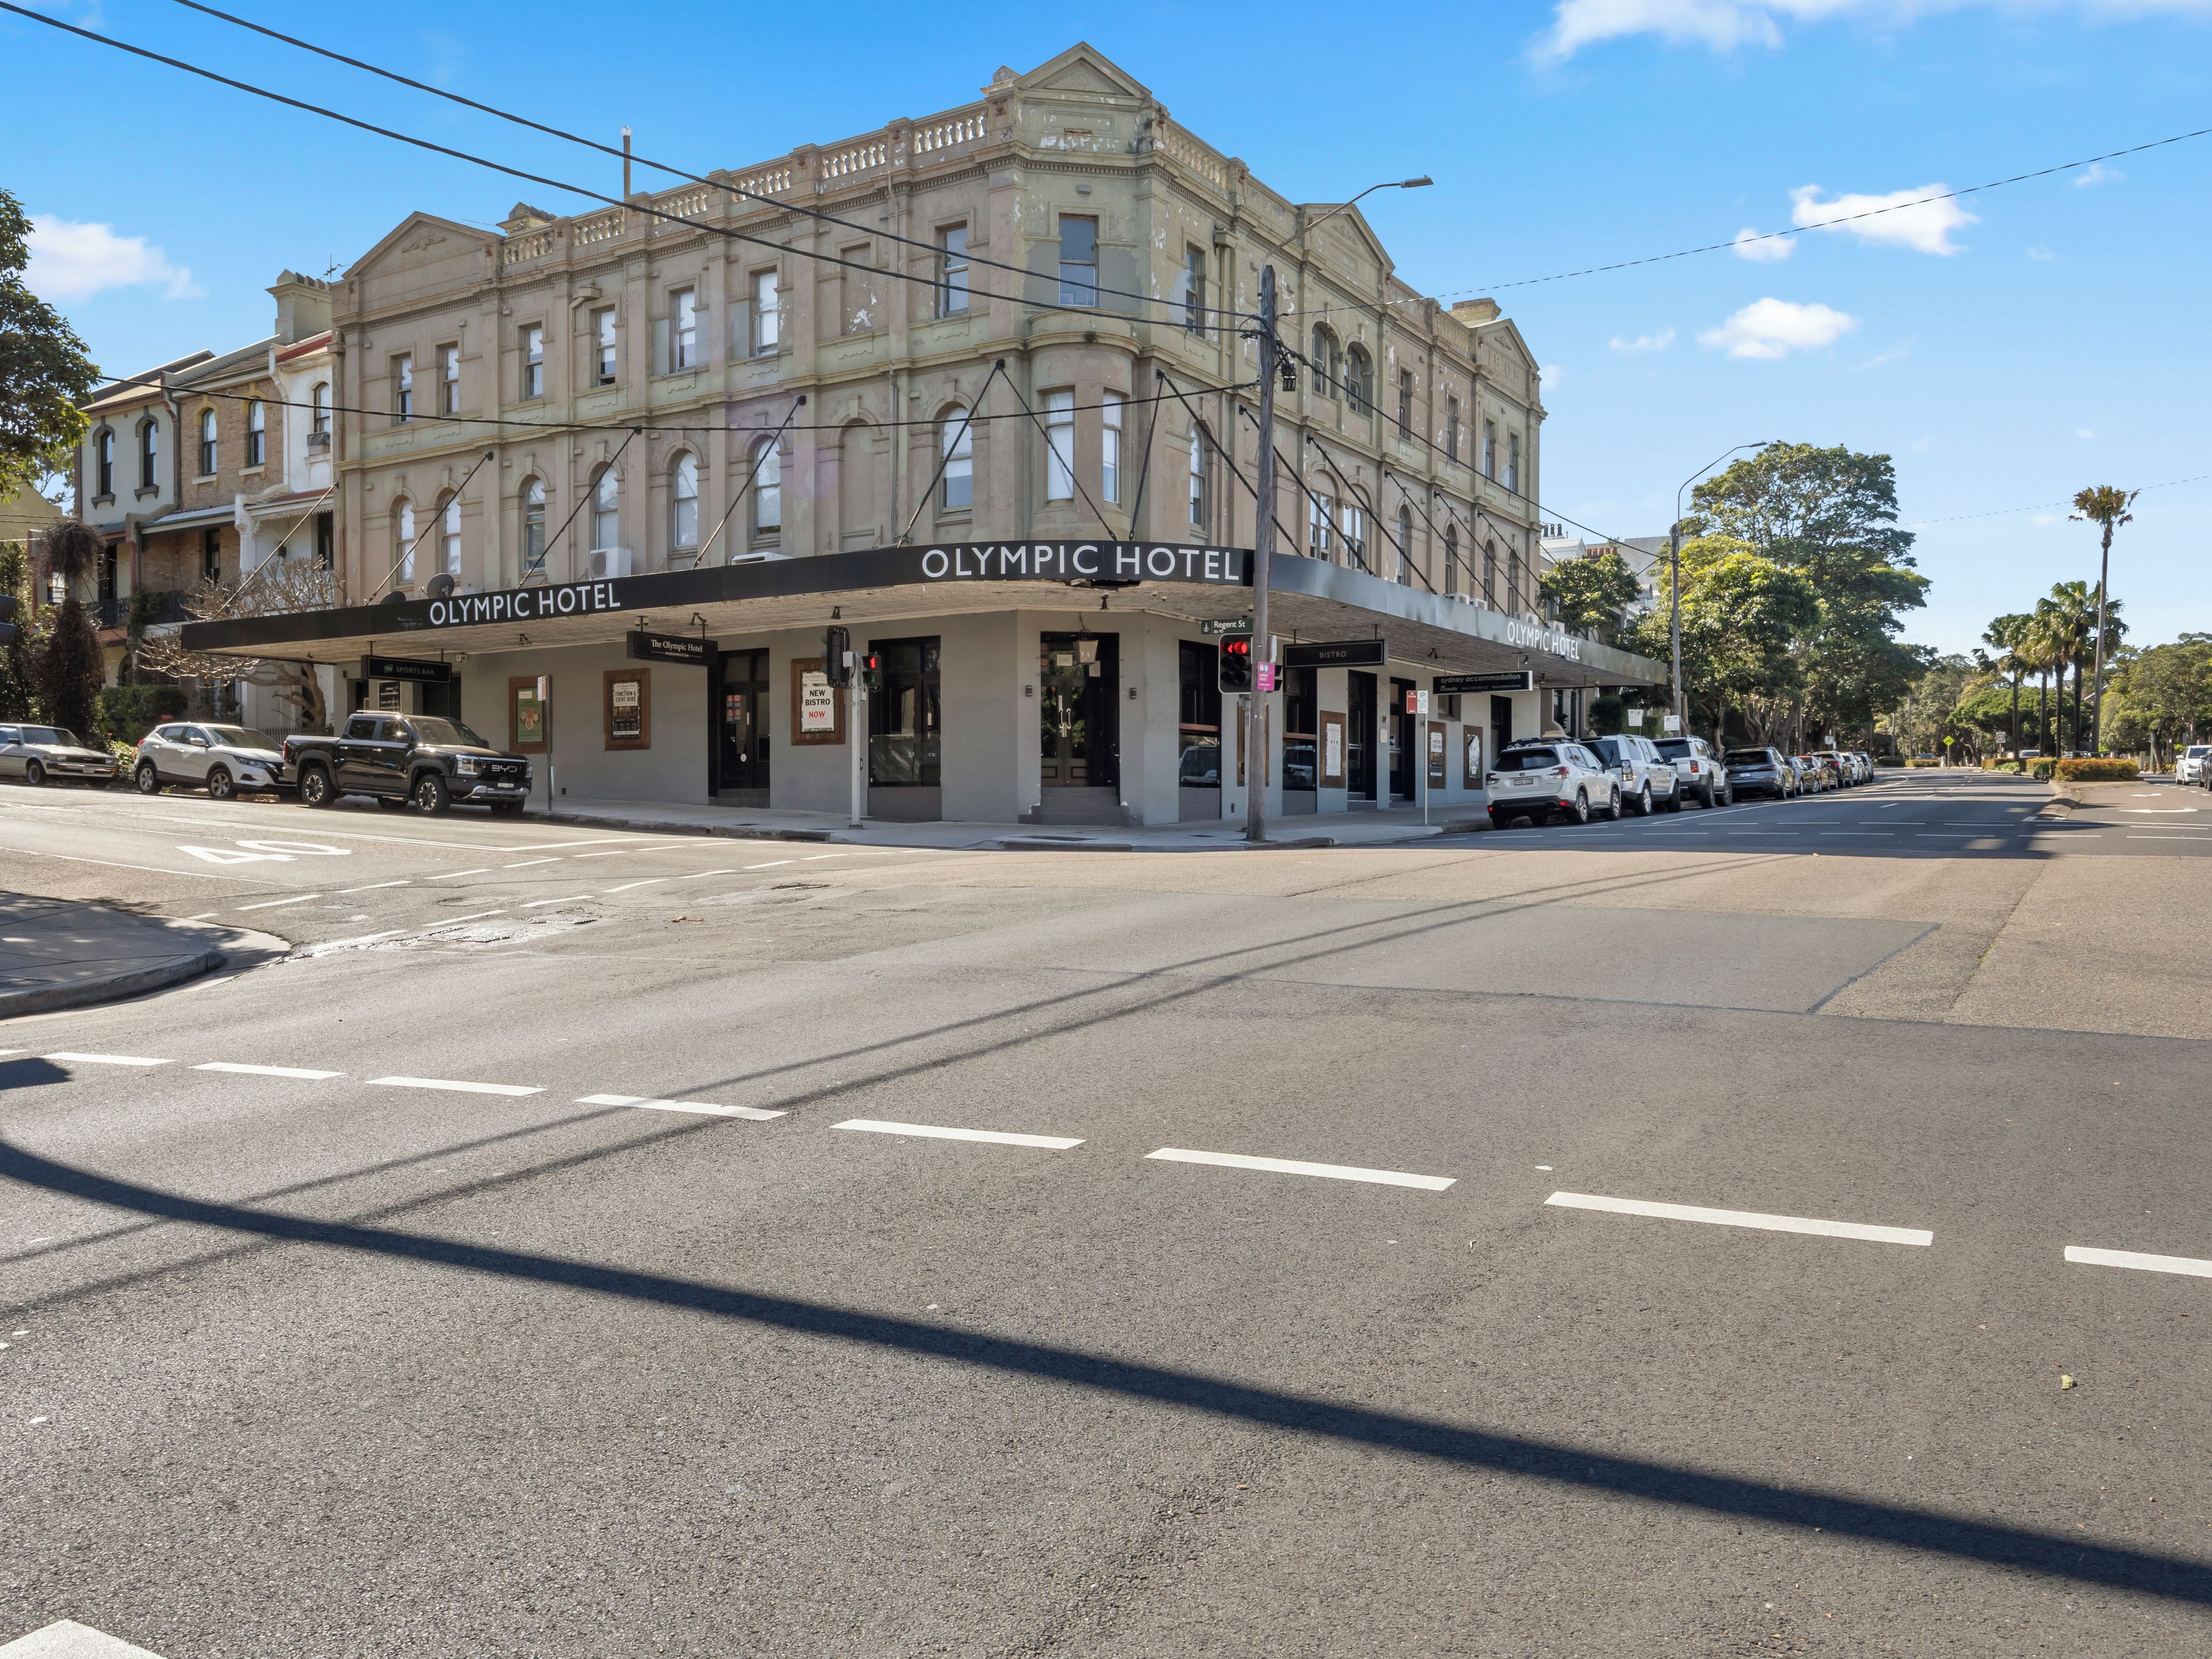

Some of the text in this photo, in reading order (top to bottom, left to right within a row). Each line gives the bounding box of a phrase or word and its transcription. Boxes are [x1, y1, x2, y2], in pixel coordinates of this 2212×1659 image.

[922, 545, 1239, 580] OLYMPIC HOTEL
[430, 583, 620, 625] OLYMPIC HOTEL
[1214, 621, 1236, 630] Regent
[651, 639, 703, 652] The Olympic Hotel
[1508, 622, 1580, 660] OLYMPIC HOTEL
[396, 666, 421, 675] SPORTS
[1441, 673, 1521, 684] sydney accommodation
[805, 698, 830, 706] BISTRO
[491, 764, 517, 772] BYD
